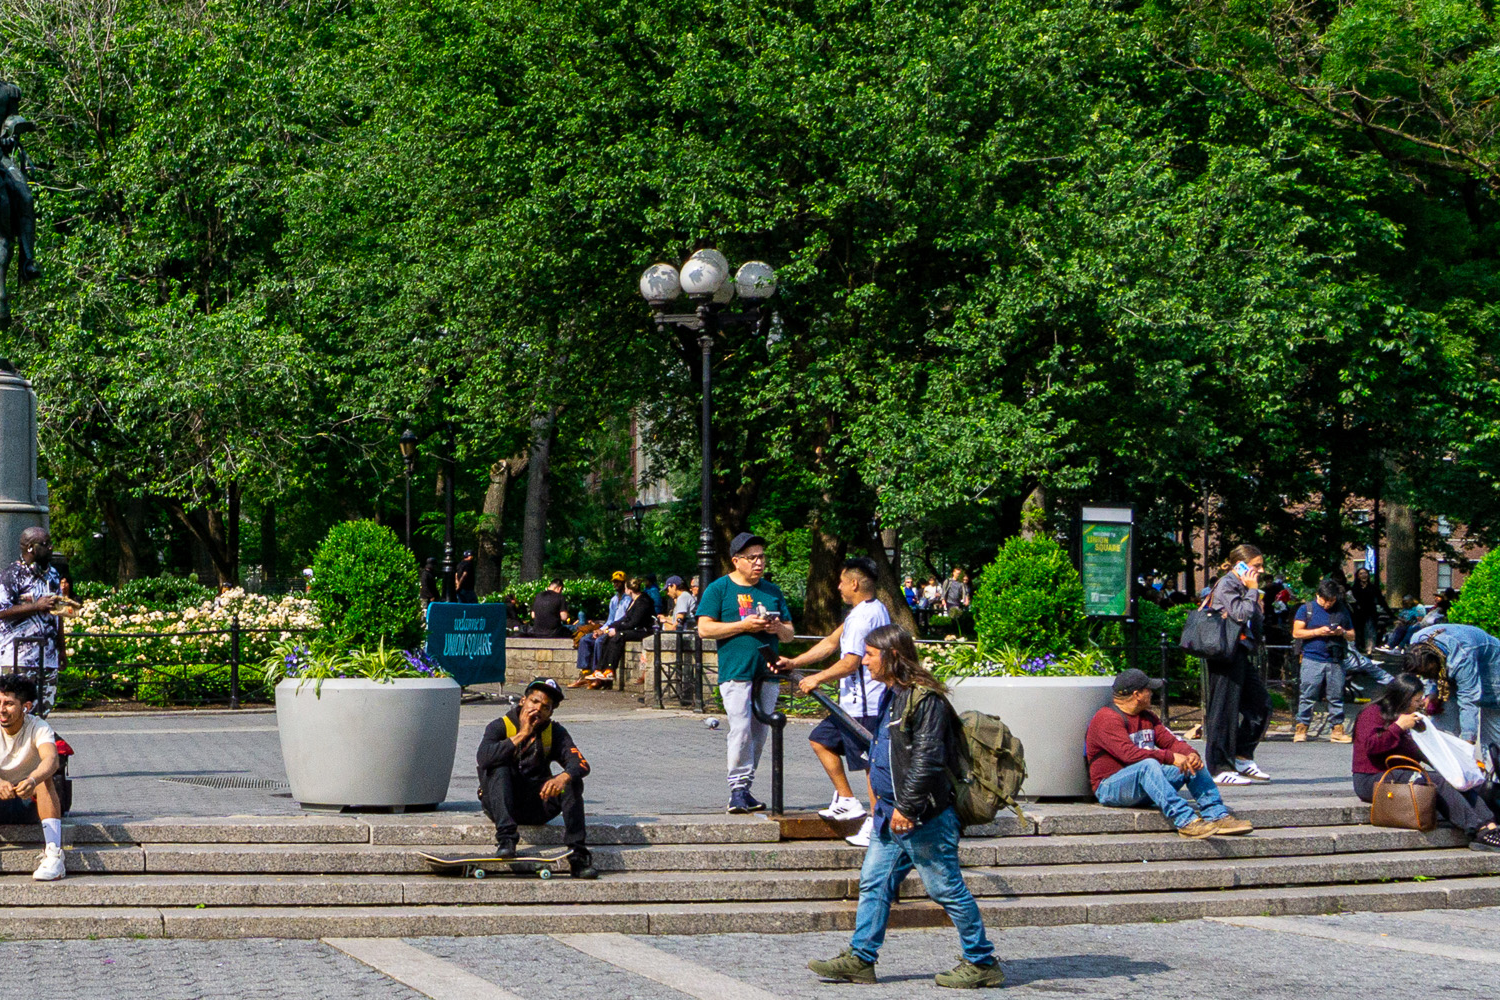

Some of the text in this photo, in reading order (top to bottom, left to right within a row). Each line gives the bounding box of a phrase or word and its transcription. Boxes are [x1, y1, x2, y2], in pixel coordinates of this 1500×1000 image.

[1095, 543, 1121, 552] SQUARE
[443, 633, 492, 660] UNION SQUARE
